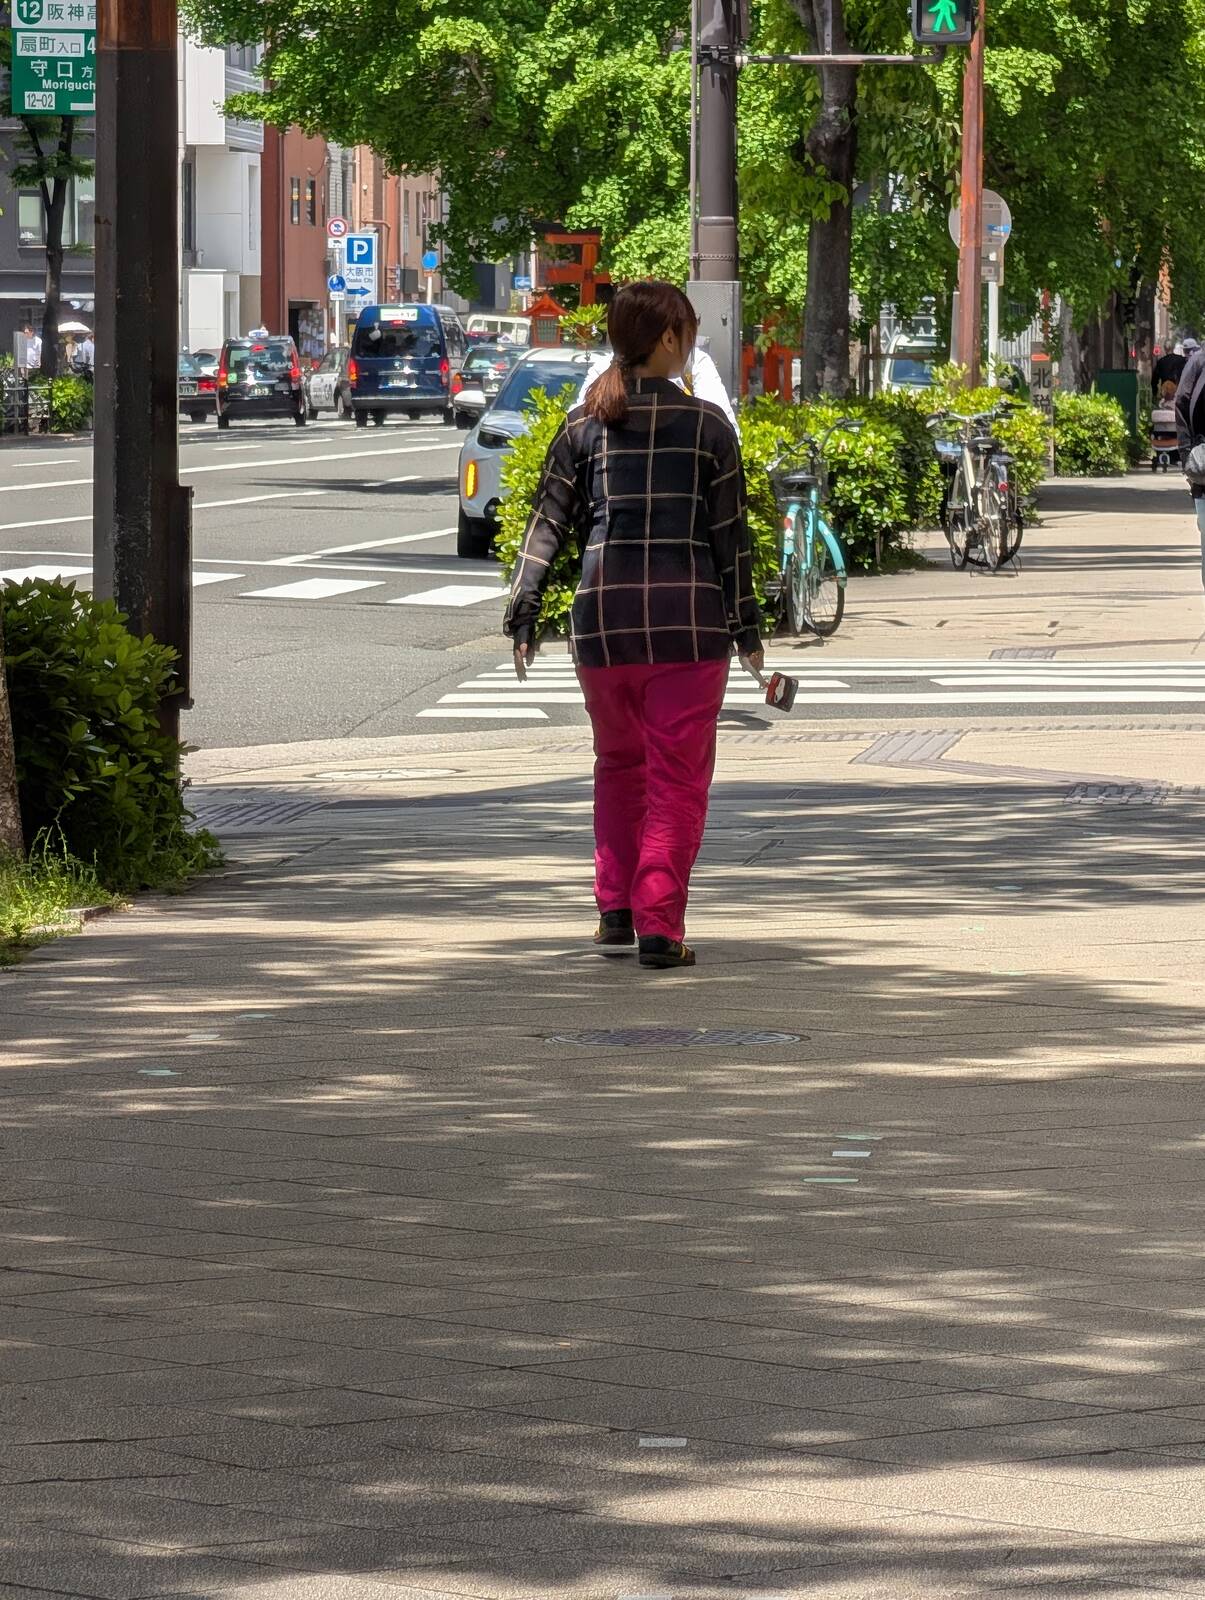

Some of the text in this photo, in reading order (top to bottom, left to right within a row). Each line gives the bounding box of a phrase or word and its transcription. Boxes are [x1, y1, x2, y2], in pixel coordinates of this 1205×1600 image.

[20, 1, 40, 18] 12
[20, 36, 81, 54] 扇町入口
[26, 94, 54, 108] 12-02
[353, 240, 368, 262] P
